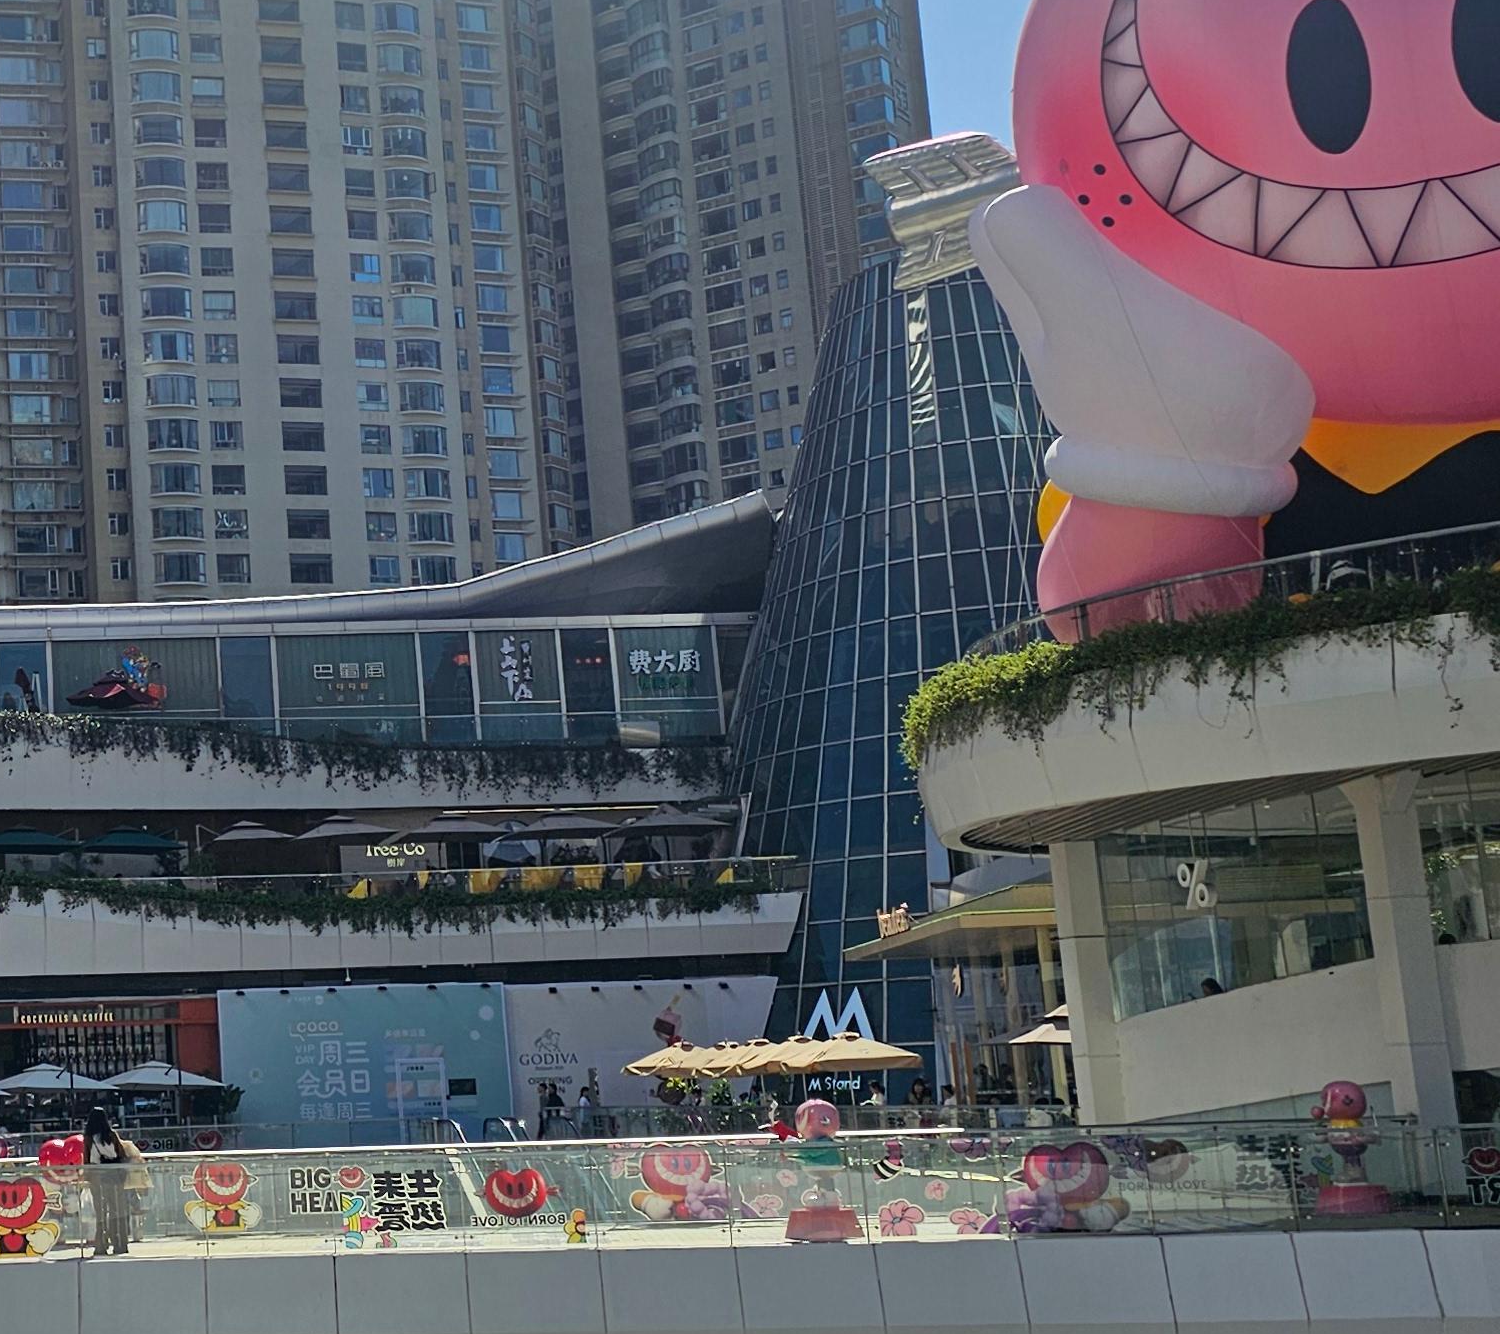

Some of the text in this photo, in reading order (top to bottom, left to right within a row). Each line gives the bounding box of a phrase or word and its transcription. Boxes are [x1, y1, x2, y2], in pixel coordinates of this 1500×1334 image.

[629, 649, 700, 674] 费大厨
[20, 1013, 69, 1025] COCKTAILS
[297, 1021, 340, 1034] COCO
[294, 1043, 316, 1054] VIP
[319, 1040, 370, 1066] 周三
[295, 1055, 316, 1066] DAY
[519, 1052, 579, 1067] GODIVA
[296, 1068, 371, 1098] 会员日
[807, 1075, 861, 1092] M Stand
[290, 1168, 331, 1189] BIG
